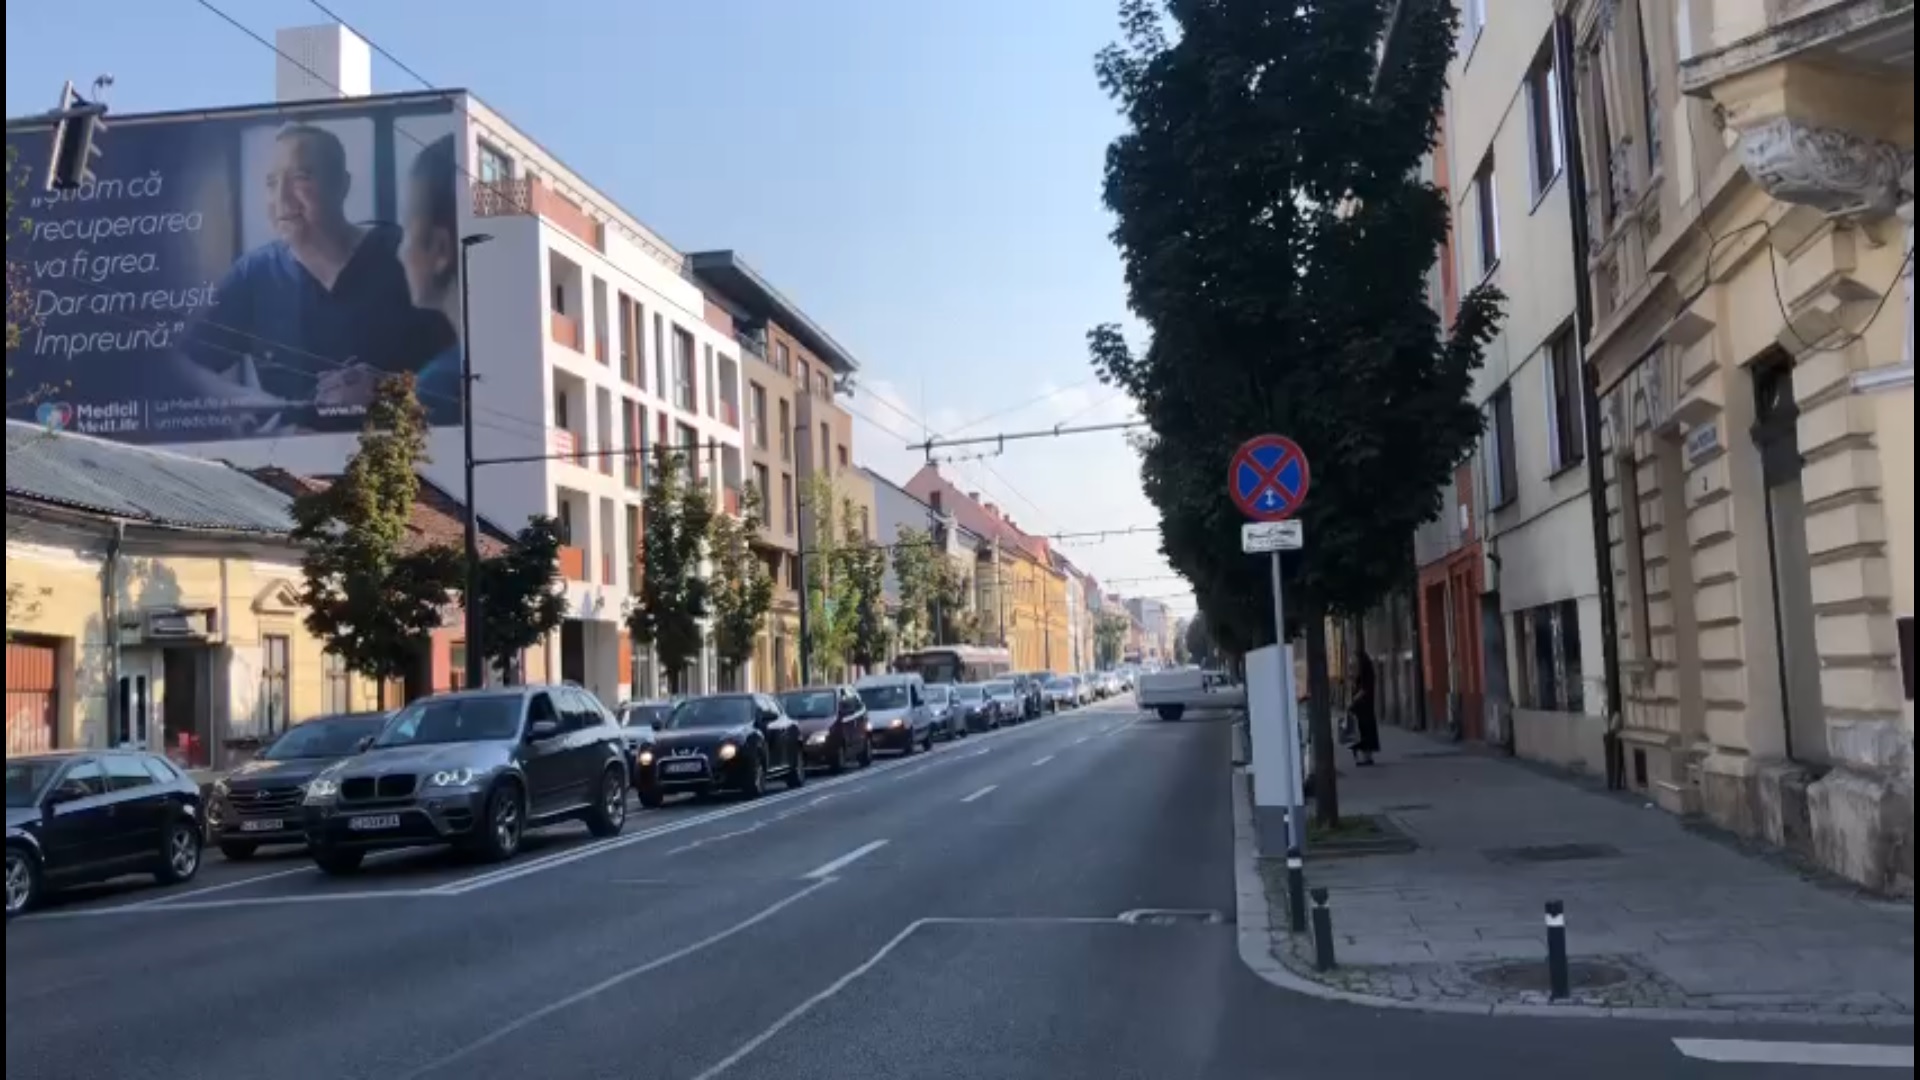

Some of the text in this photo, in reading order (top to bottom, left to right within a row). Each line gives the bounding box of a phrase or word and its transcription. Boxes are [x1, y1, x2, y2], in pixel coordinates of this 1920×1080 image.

[128, 169, 163, 197] că
[33, 211, 204, 244] recuperarea
[34, 249, 160, 283] va fi grea.
[35, 280, 221, 317] Dar am reușit.
